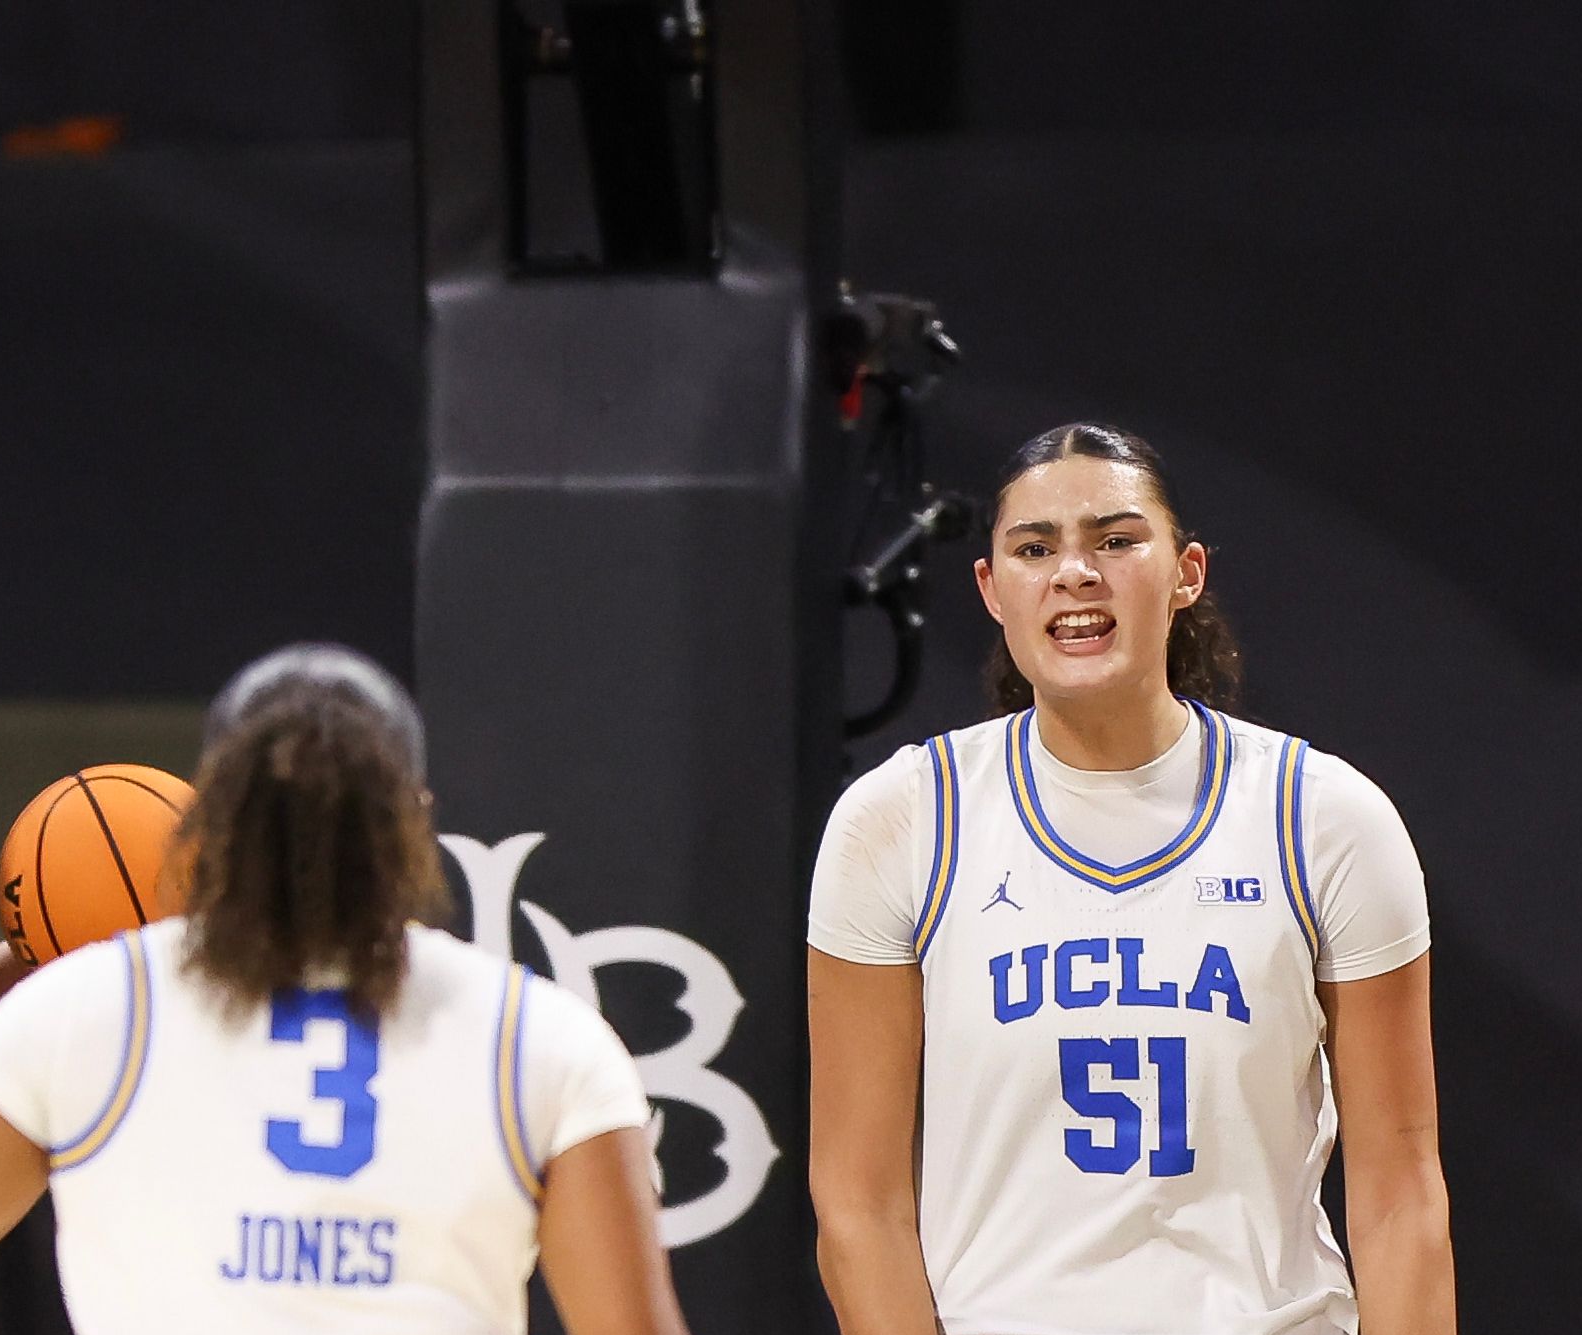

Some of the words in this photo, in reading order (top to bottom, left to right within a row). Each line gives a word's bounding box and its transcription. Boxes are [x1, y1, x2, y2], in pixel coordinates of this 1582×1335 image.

[988, 936, 1251, 1025] UCLA
[266, 985, 382, 1179] 3
[1058, 1036, 1196, 1178] 51
[217, 1215, 395, 1286] JONES
